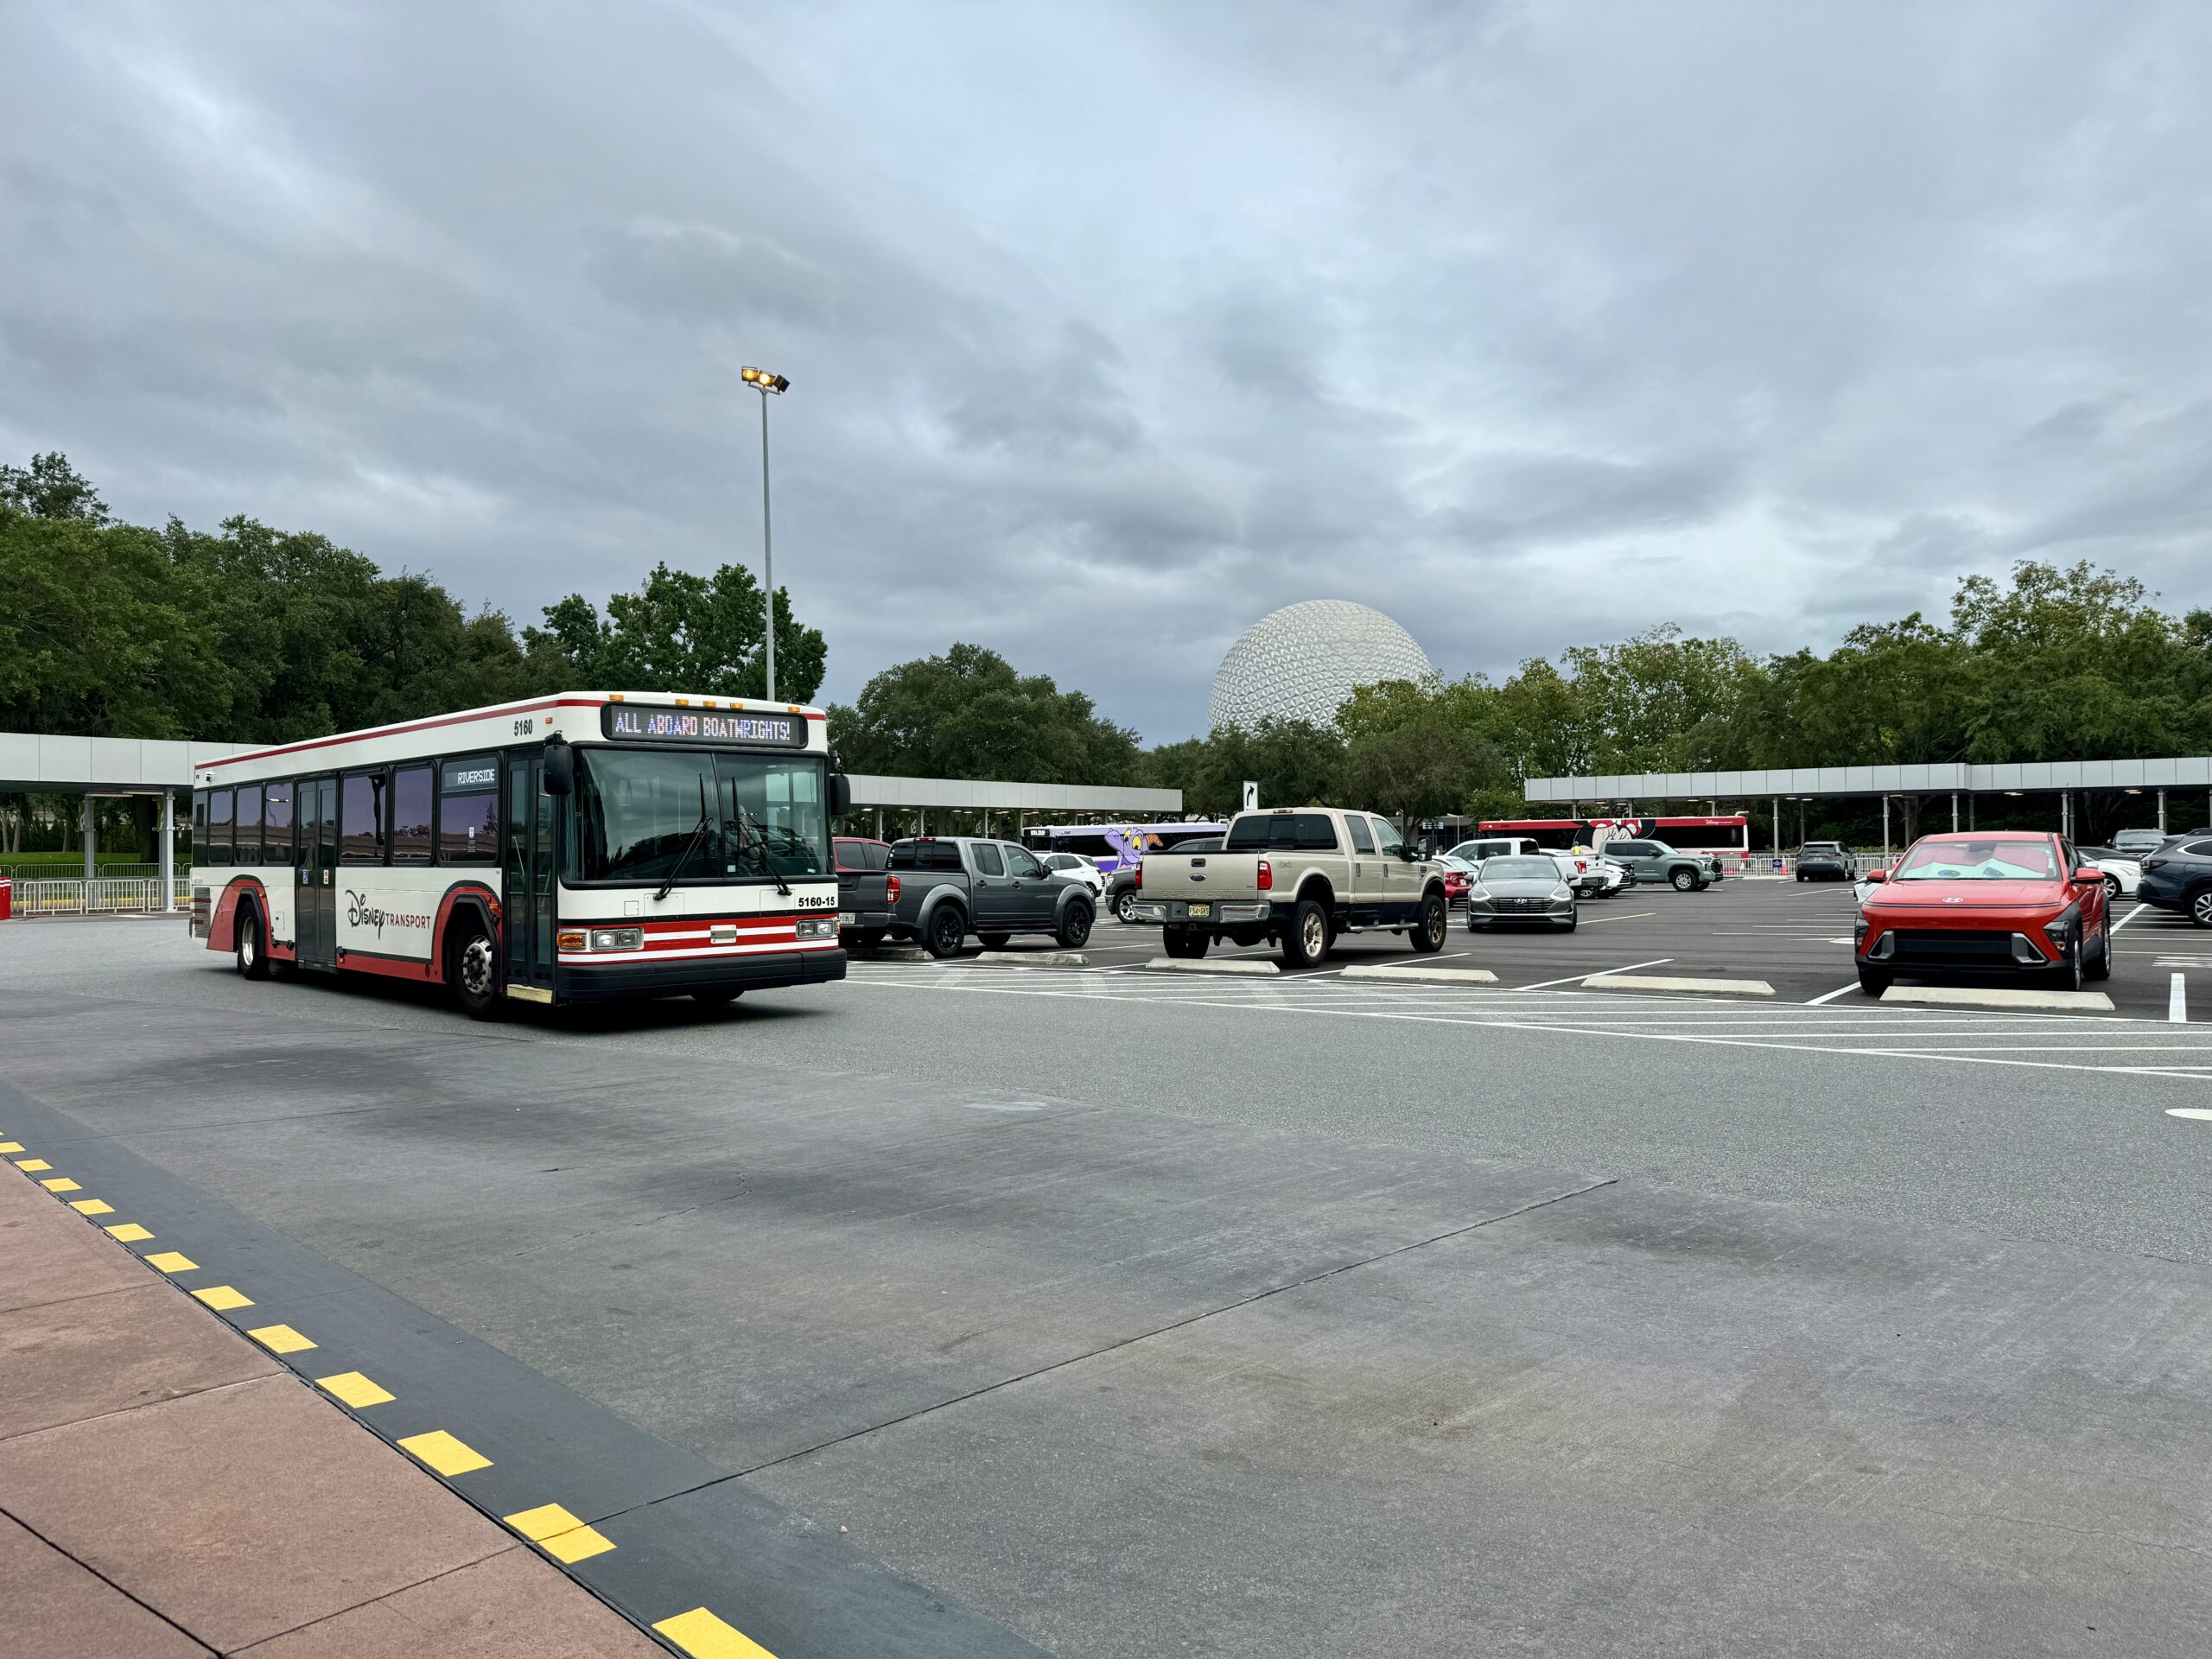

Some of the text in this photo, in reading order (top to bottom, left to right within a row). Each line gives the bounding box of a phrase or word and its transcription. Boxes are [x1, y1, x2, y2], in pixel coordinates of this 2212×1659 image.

[513, 718, 533, 736] 5160
[615, 712, 790, 741] ALL ABOARD BOATWRIGHTS!
[457, 768, 495, 785] RIVERSIDE
[798, 896, 835, 906] 5160-15
[385, 913, 431, 929] TRANSPORT
